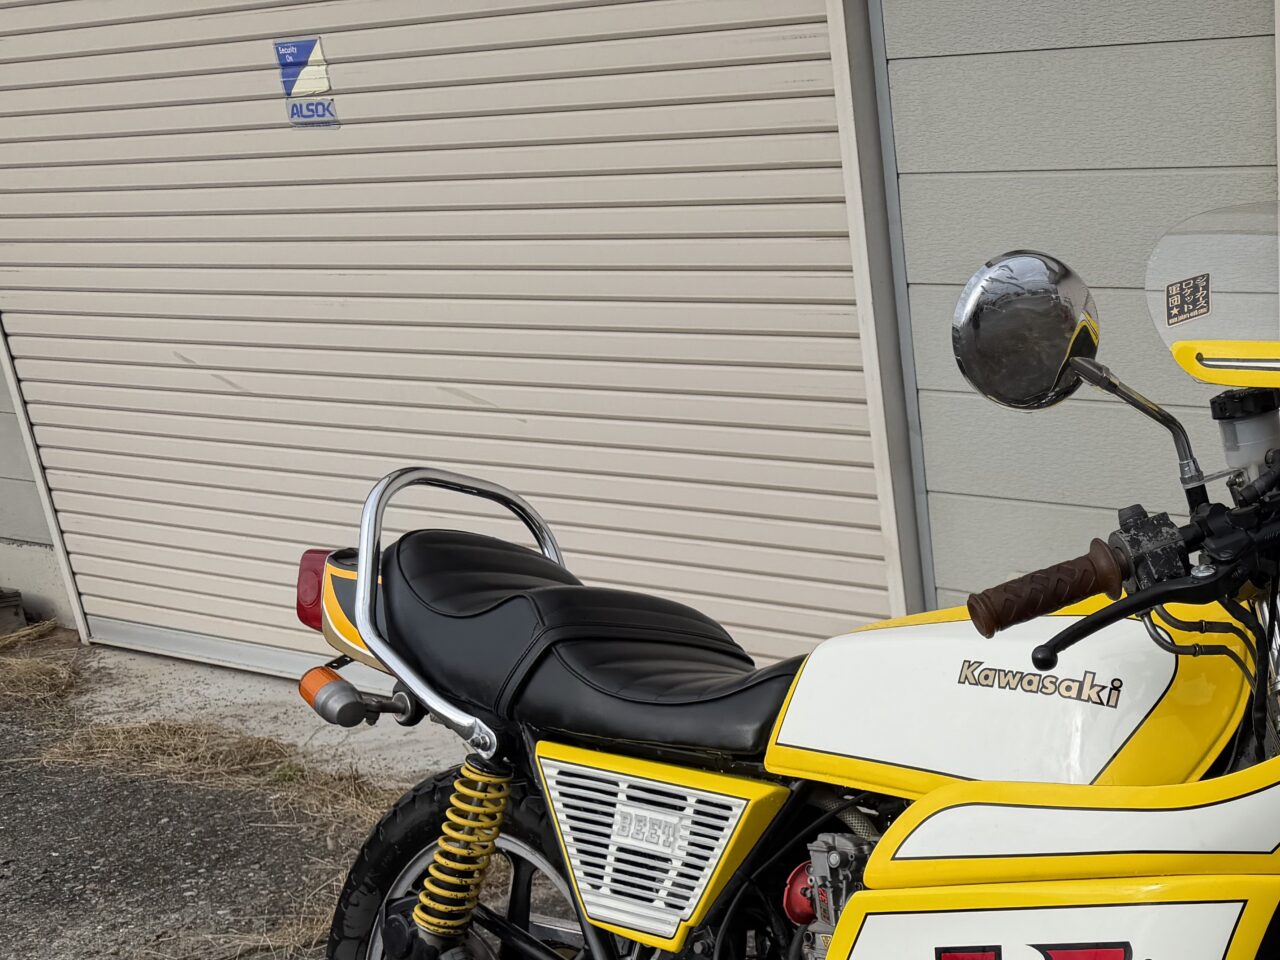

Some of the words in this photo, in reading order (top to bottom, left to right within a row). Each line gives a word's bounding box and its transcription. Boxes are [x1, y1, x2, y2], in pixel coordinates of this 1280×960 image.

[290, 101, 335, 118] ALSOK
[1182, 279, 1194, 313] ロケット
[1195, 274, 1208, 310] ジョーカーズ
[958, 660, 1123, 709] Kawasaki
[616, 811, 677, 848] BEET
